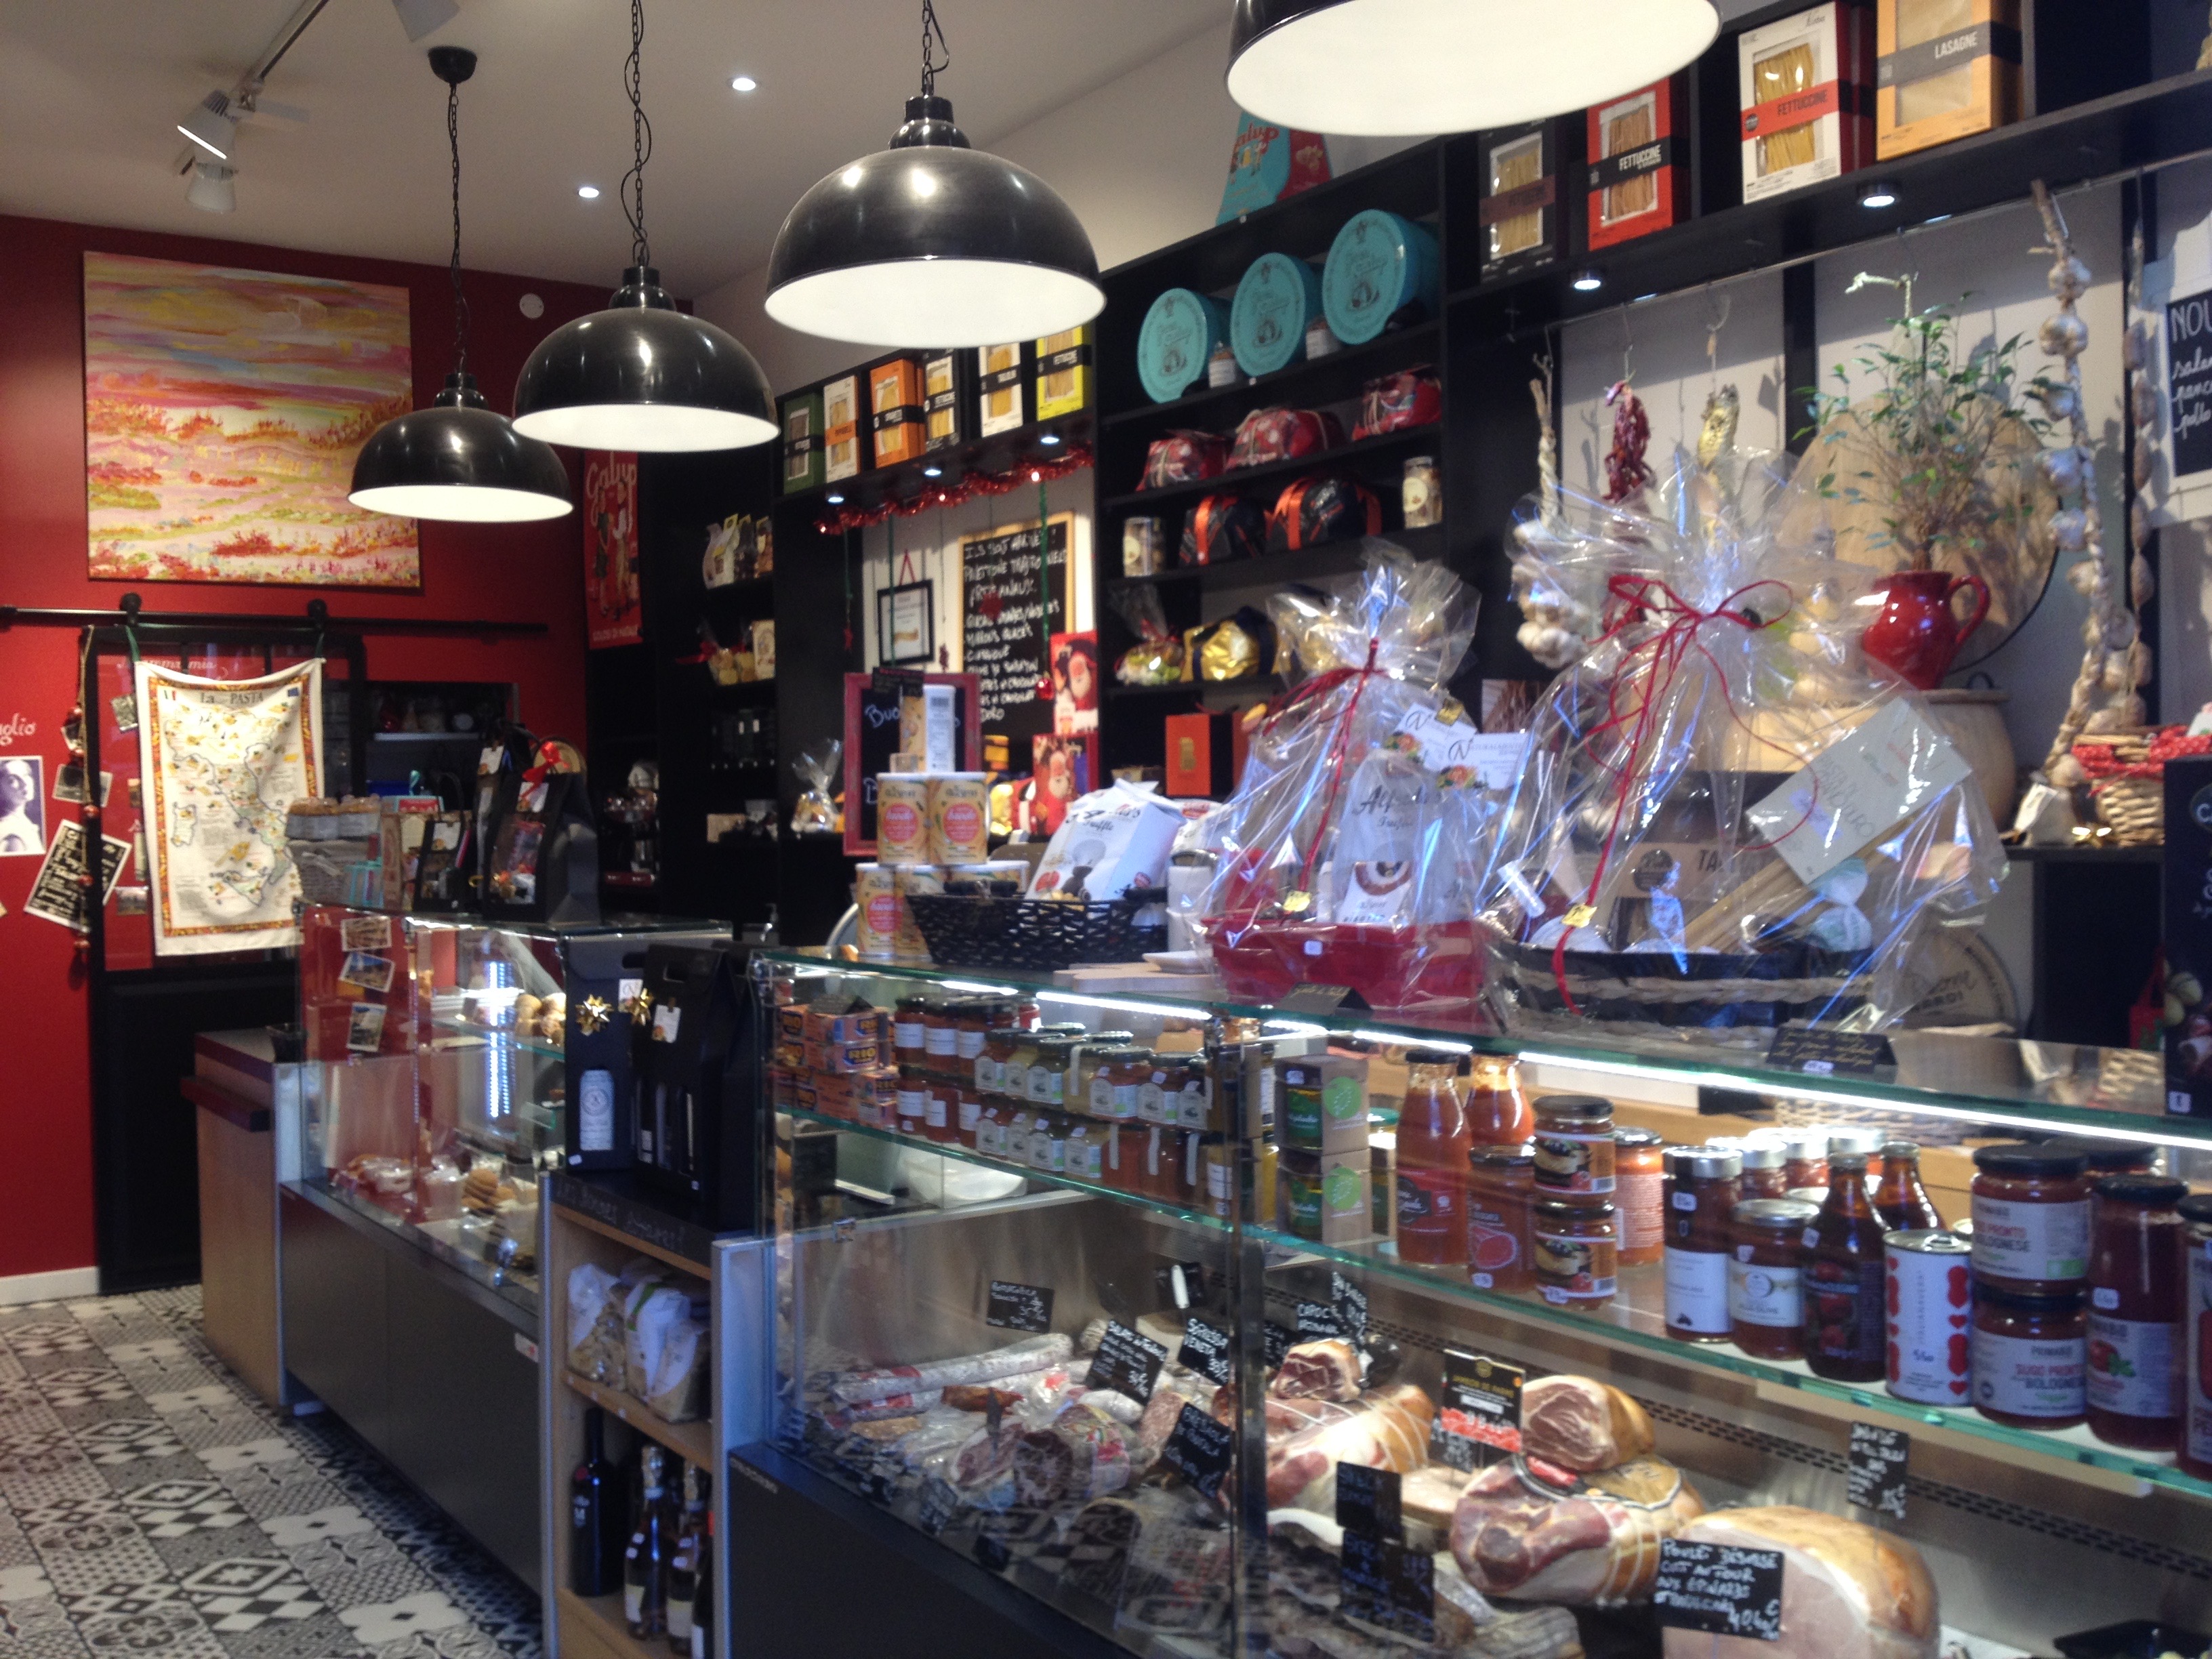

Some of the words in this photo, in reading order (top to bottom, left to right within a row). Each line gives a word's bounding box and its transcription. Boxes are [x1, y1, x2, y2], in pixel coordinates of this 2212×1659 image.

[1933, 30, 1978, 60] LASAGNE
[1777, 89, 1828, 117] FETTUCCINE
[1618, 144, 1662, 171] FETTUCCINE
[230, 691, 264, 704] PASTA
